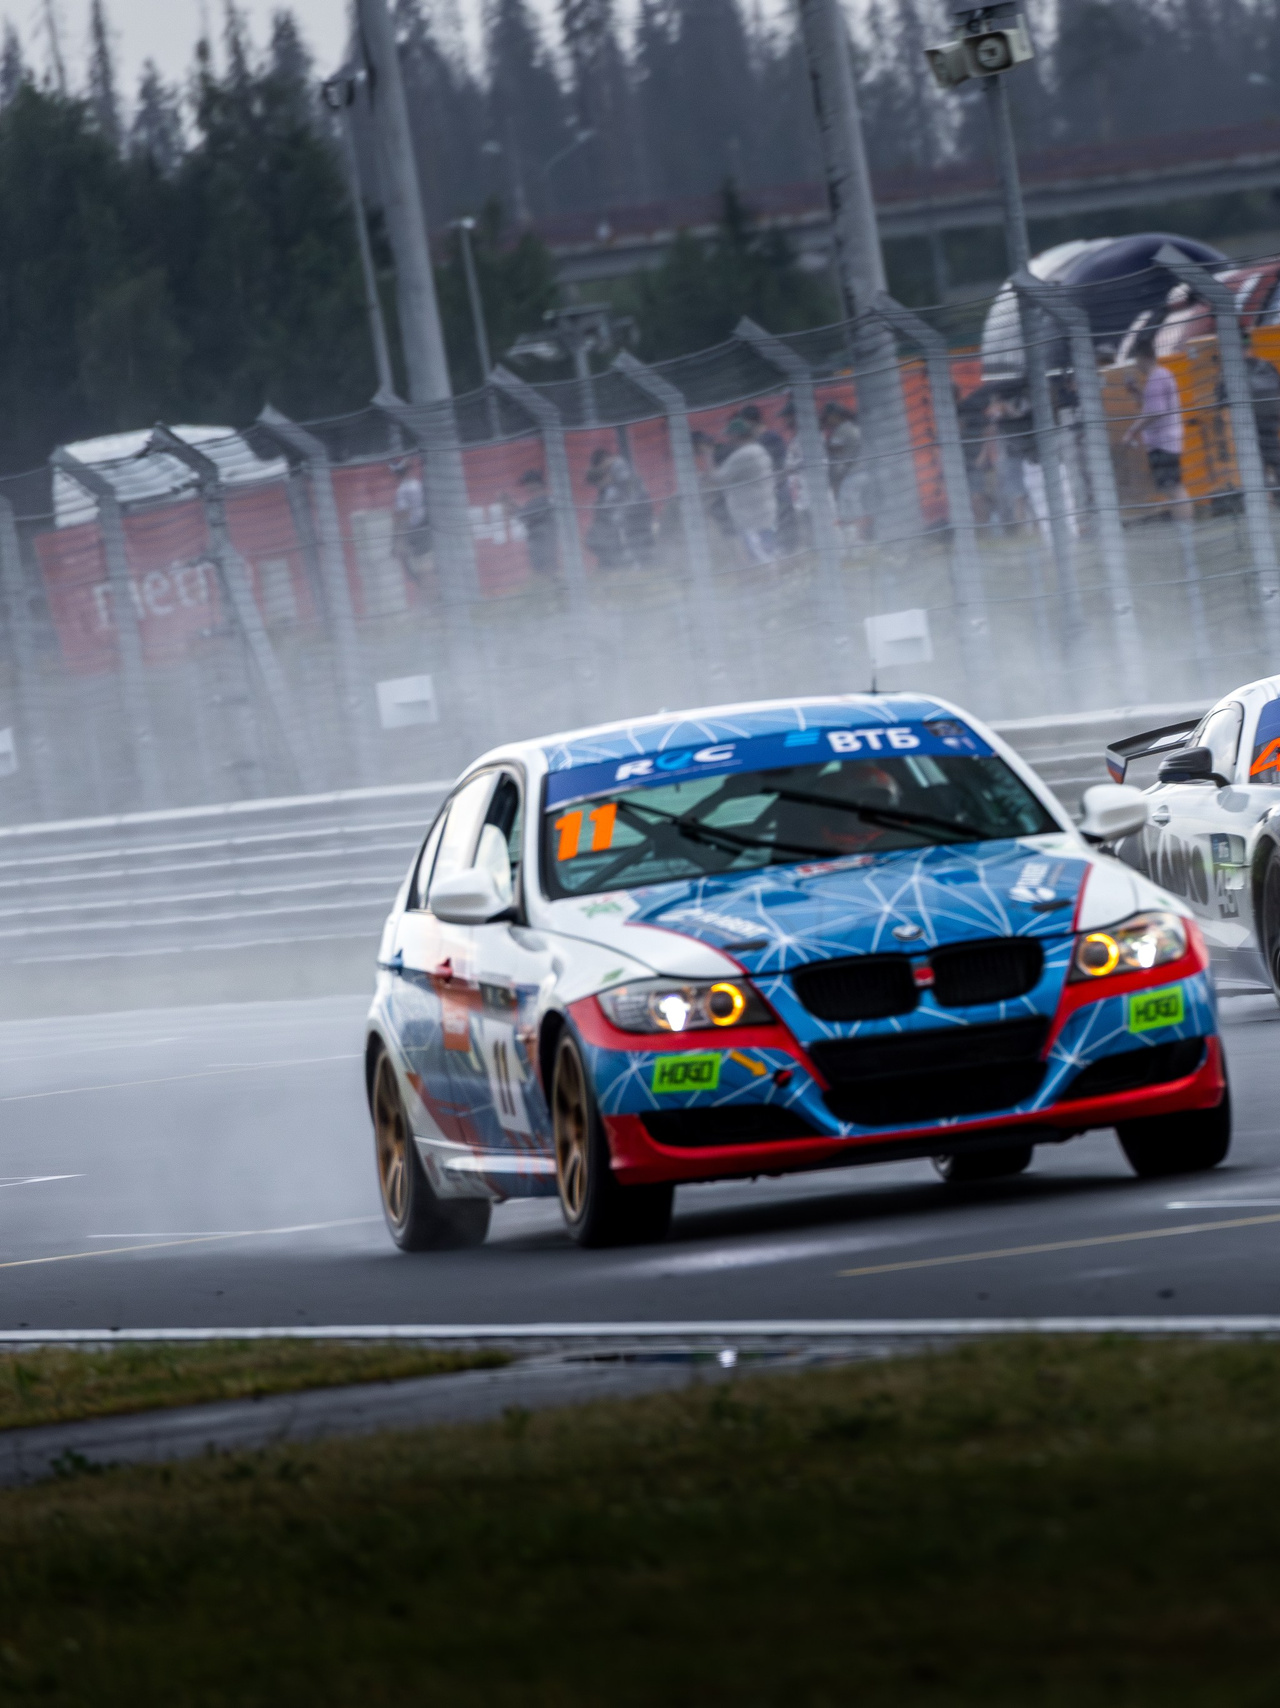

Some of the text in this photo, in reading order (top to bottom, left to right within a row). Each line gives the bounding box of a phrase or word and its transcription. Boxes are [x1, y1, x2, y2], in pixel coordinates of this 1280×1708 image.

[826, 726, 921, 753] ВТБ
[554, 802, 617, 861] 11
[659, 1060, 715, 1086] HOGO
